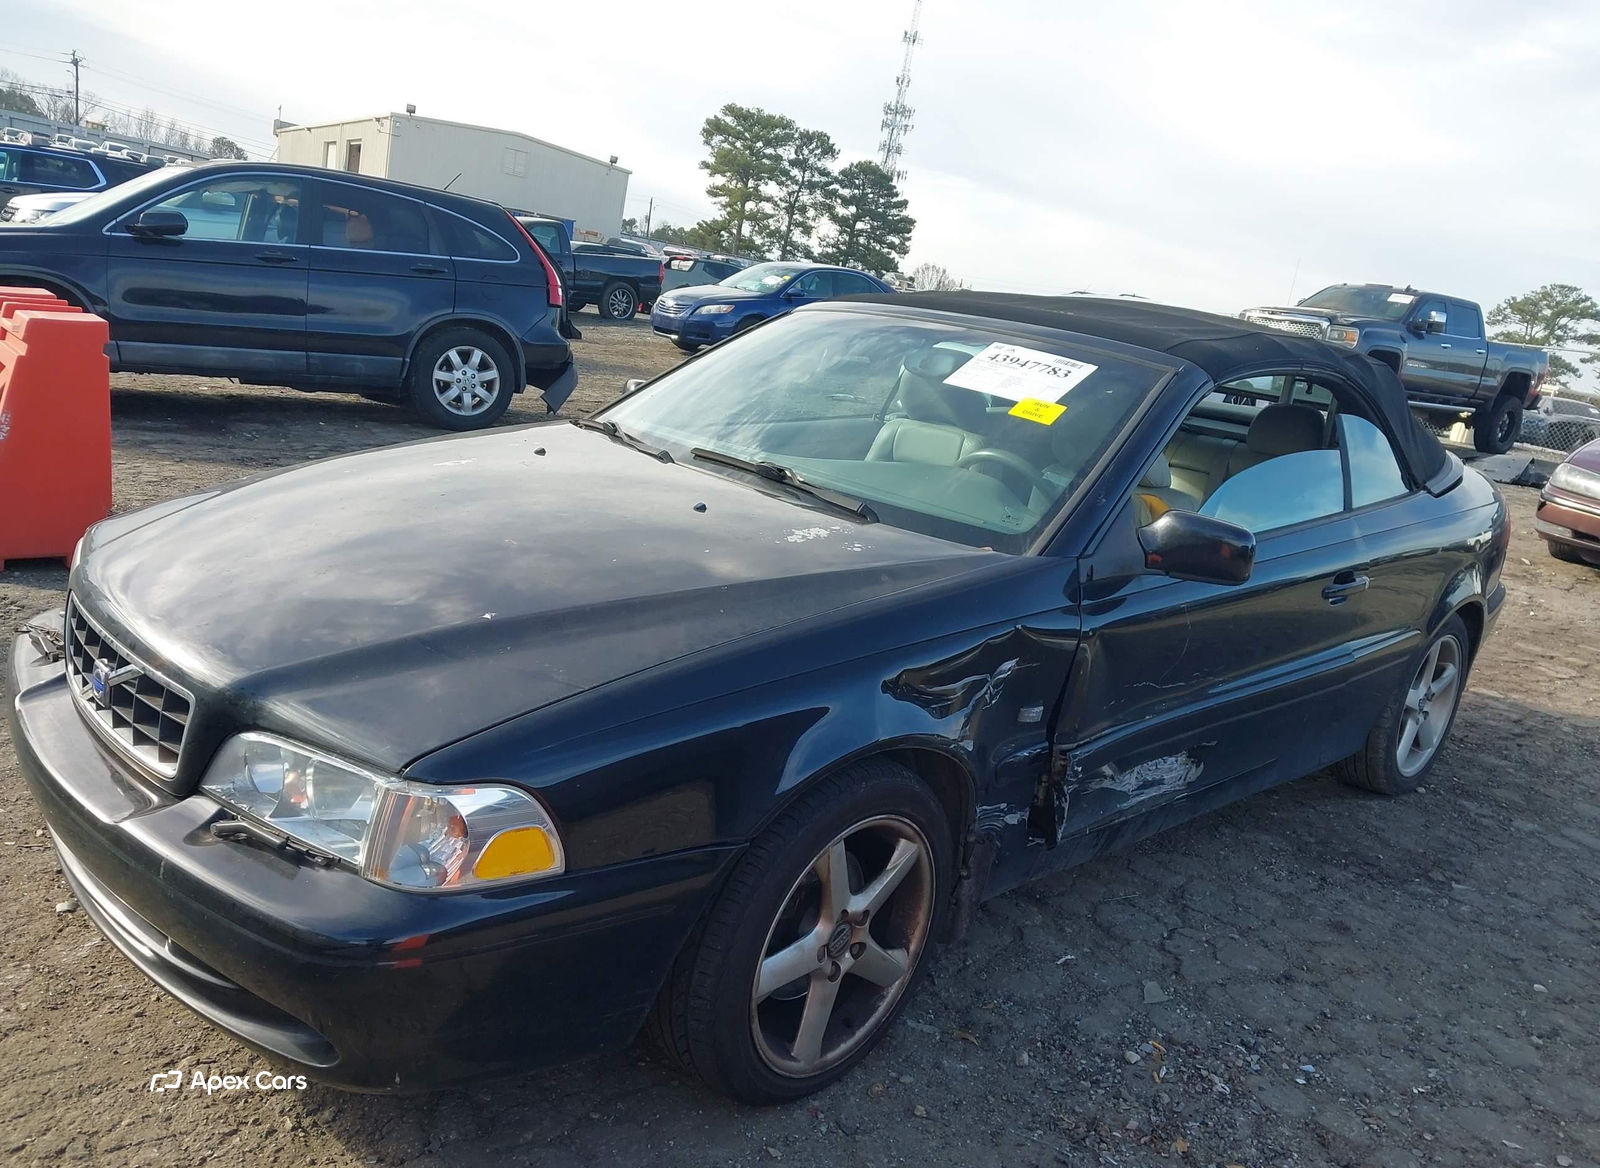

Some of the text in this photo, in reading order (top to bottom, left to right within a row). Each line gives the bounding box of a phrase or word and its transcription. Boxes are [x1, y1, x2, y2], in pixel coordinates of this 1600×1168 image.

[987, 353, 1072, 379] 43947783
[1033, 401, 1050, 409] RUN
[1021, 409, 1045, 418] DRIVE
